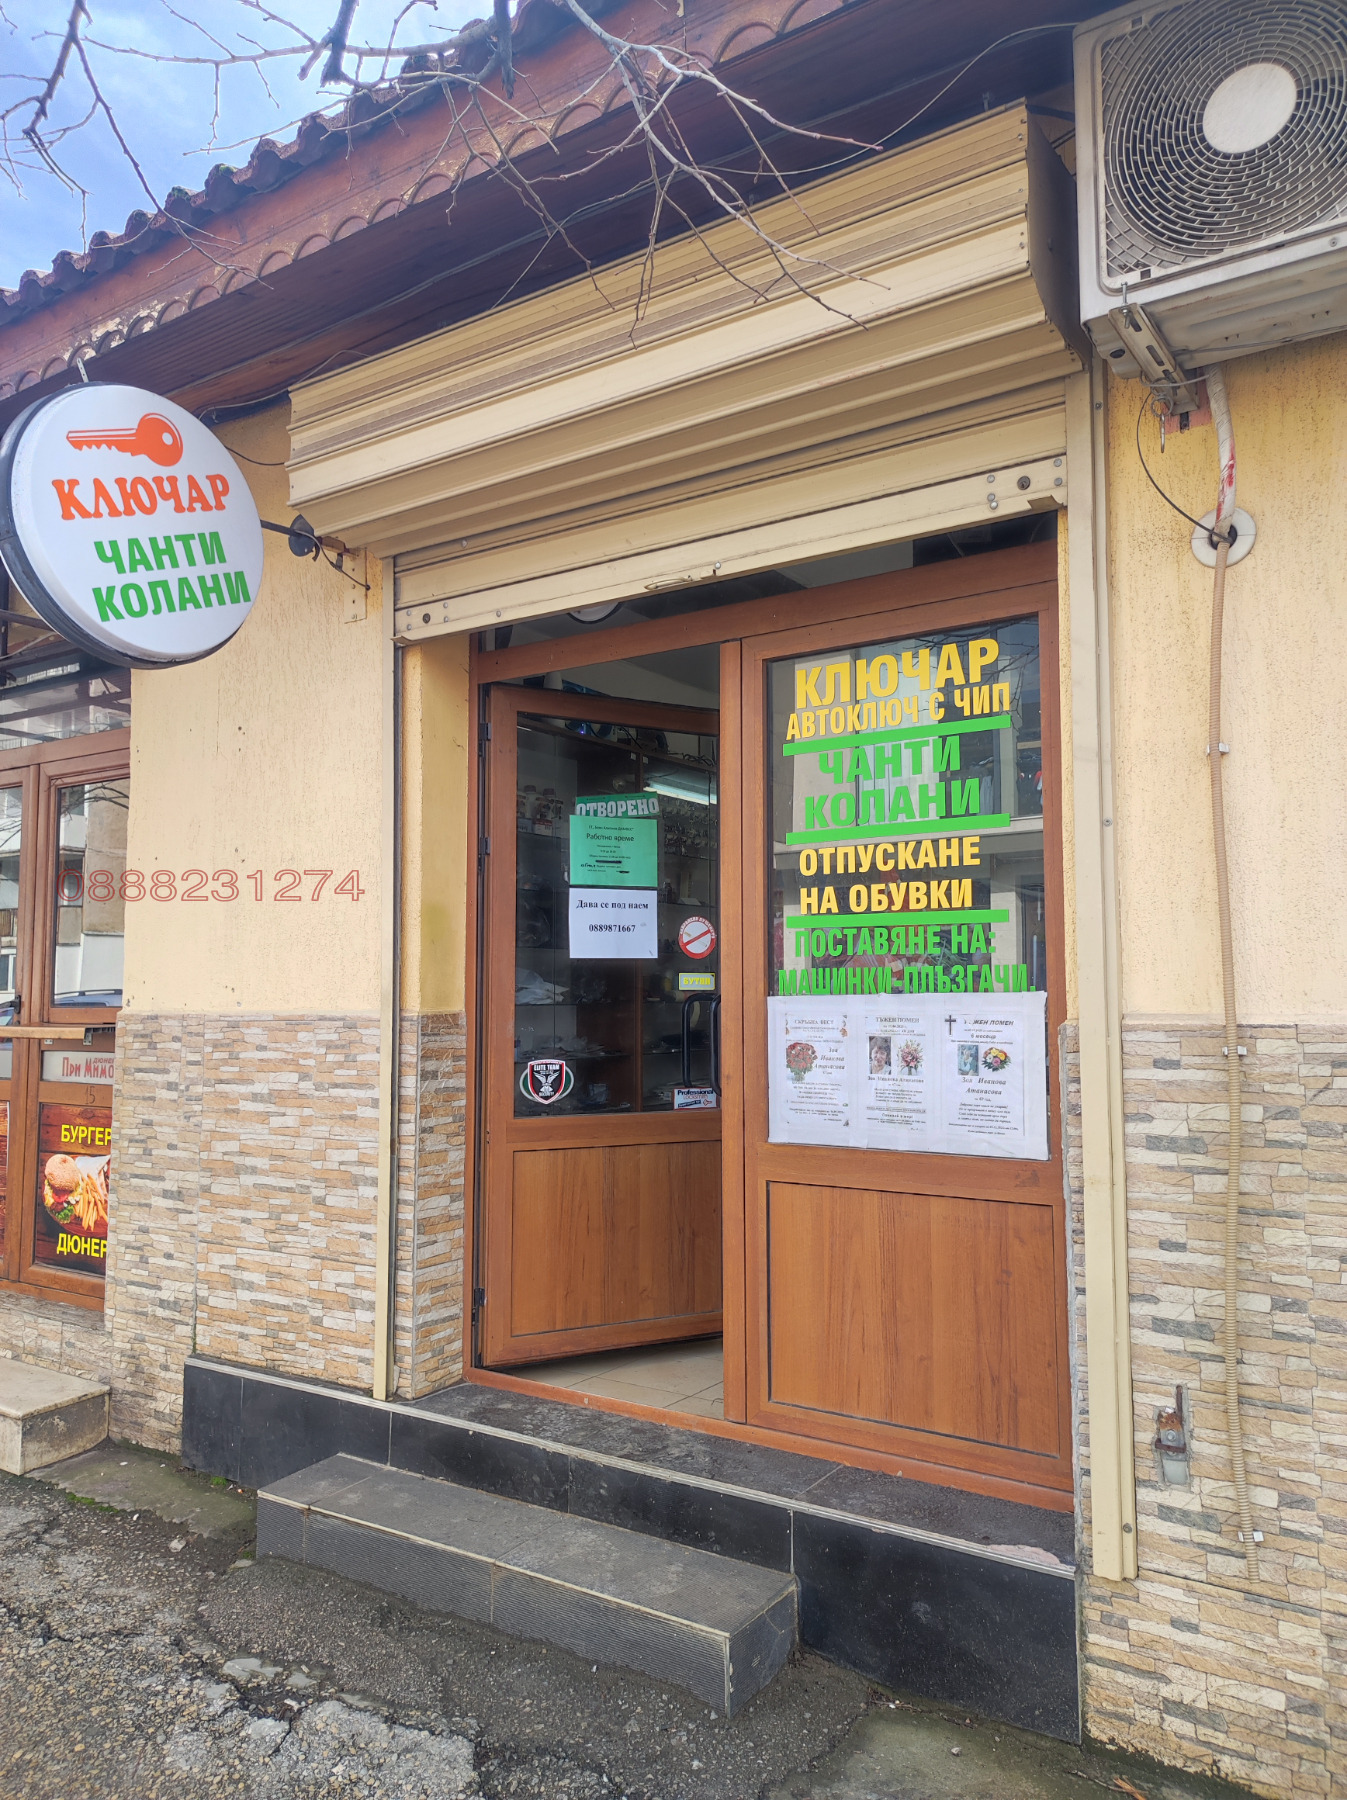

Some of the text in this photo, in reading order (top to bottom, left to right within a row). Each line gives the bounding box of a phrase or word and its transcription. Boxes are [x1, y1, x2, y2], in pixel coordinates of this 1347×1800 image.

[51, 473, 230, 521] КЛЮЧАР
[94, 531, 227, 575] ЧАНТИ
[91, 570, 252, 622] КОЛАНИ
[796, 638, 1000, 709] КЛЮЧАР
[786, 682, 1010, 740] АВТОКЛЮЧ С ЧИП
[818, 735, 961, 784] ЧАНТИ
[576, 798, 660, 817] ОТВОРЕНО
[804, 778, 980, 830] КОЛАНИ
[586, 832, 613, 841] Работно
[799, 835, 981, 877] ОТПУСКАНЕ
[576, 900, 598, 909] Дава
[800, 878, 973, 915] НА ОБУВКИ
[794, 923, 996, 958] ПОСТАВЯНЕ НА:
